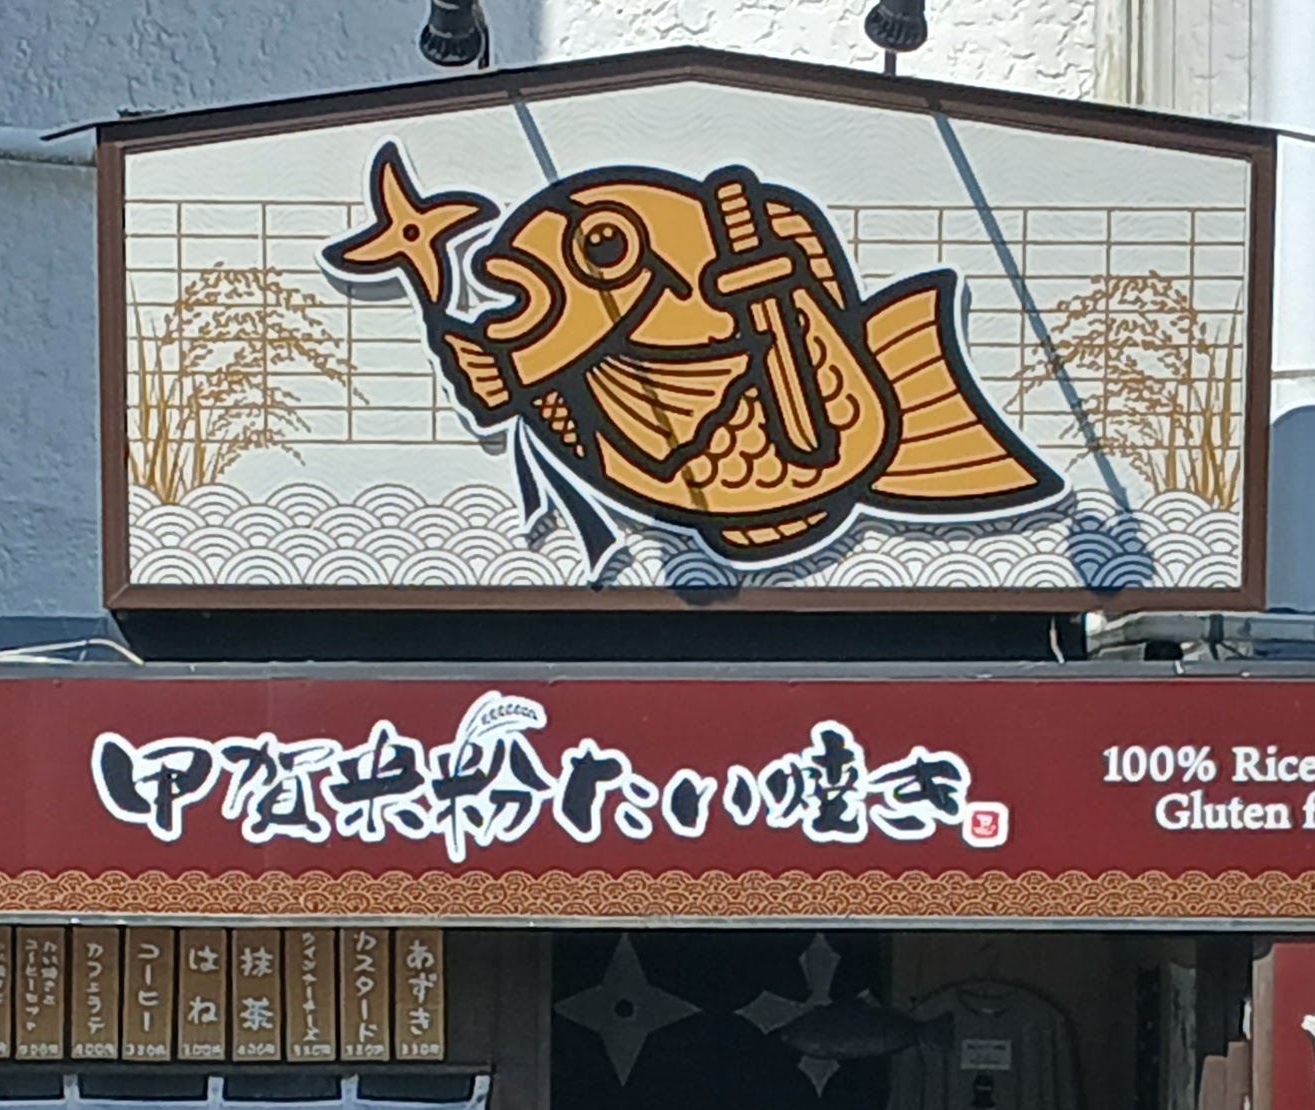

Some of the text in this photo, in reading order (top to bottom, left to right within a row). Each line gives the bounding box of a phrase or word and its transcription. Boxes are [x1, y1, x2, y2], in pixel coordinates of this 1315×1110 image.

[92, 715, 972, 862] 甲賀米粉たい焼き
[1102, 746, 1217, 783] 100%
[1155, 790, 1289, 830] Gluten
[138, 943, 161, 1032] コーヒー
[188, 946, 219, 1024] はね
[240, 946, 275, 1032] 抹茶
[353, 931, 378, 1043] カスタード
[406, 939, 438, 1036] あずき
